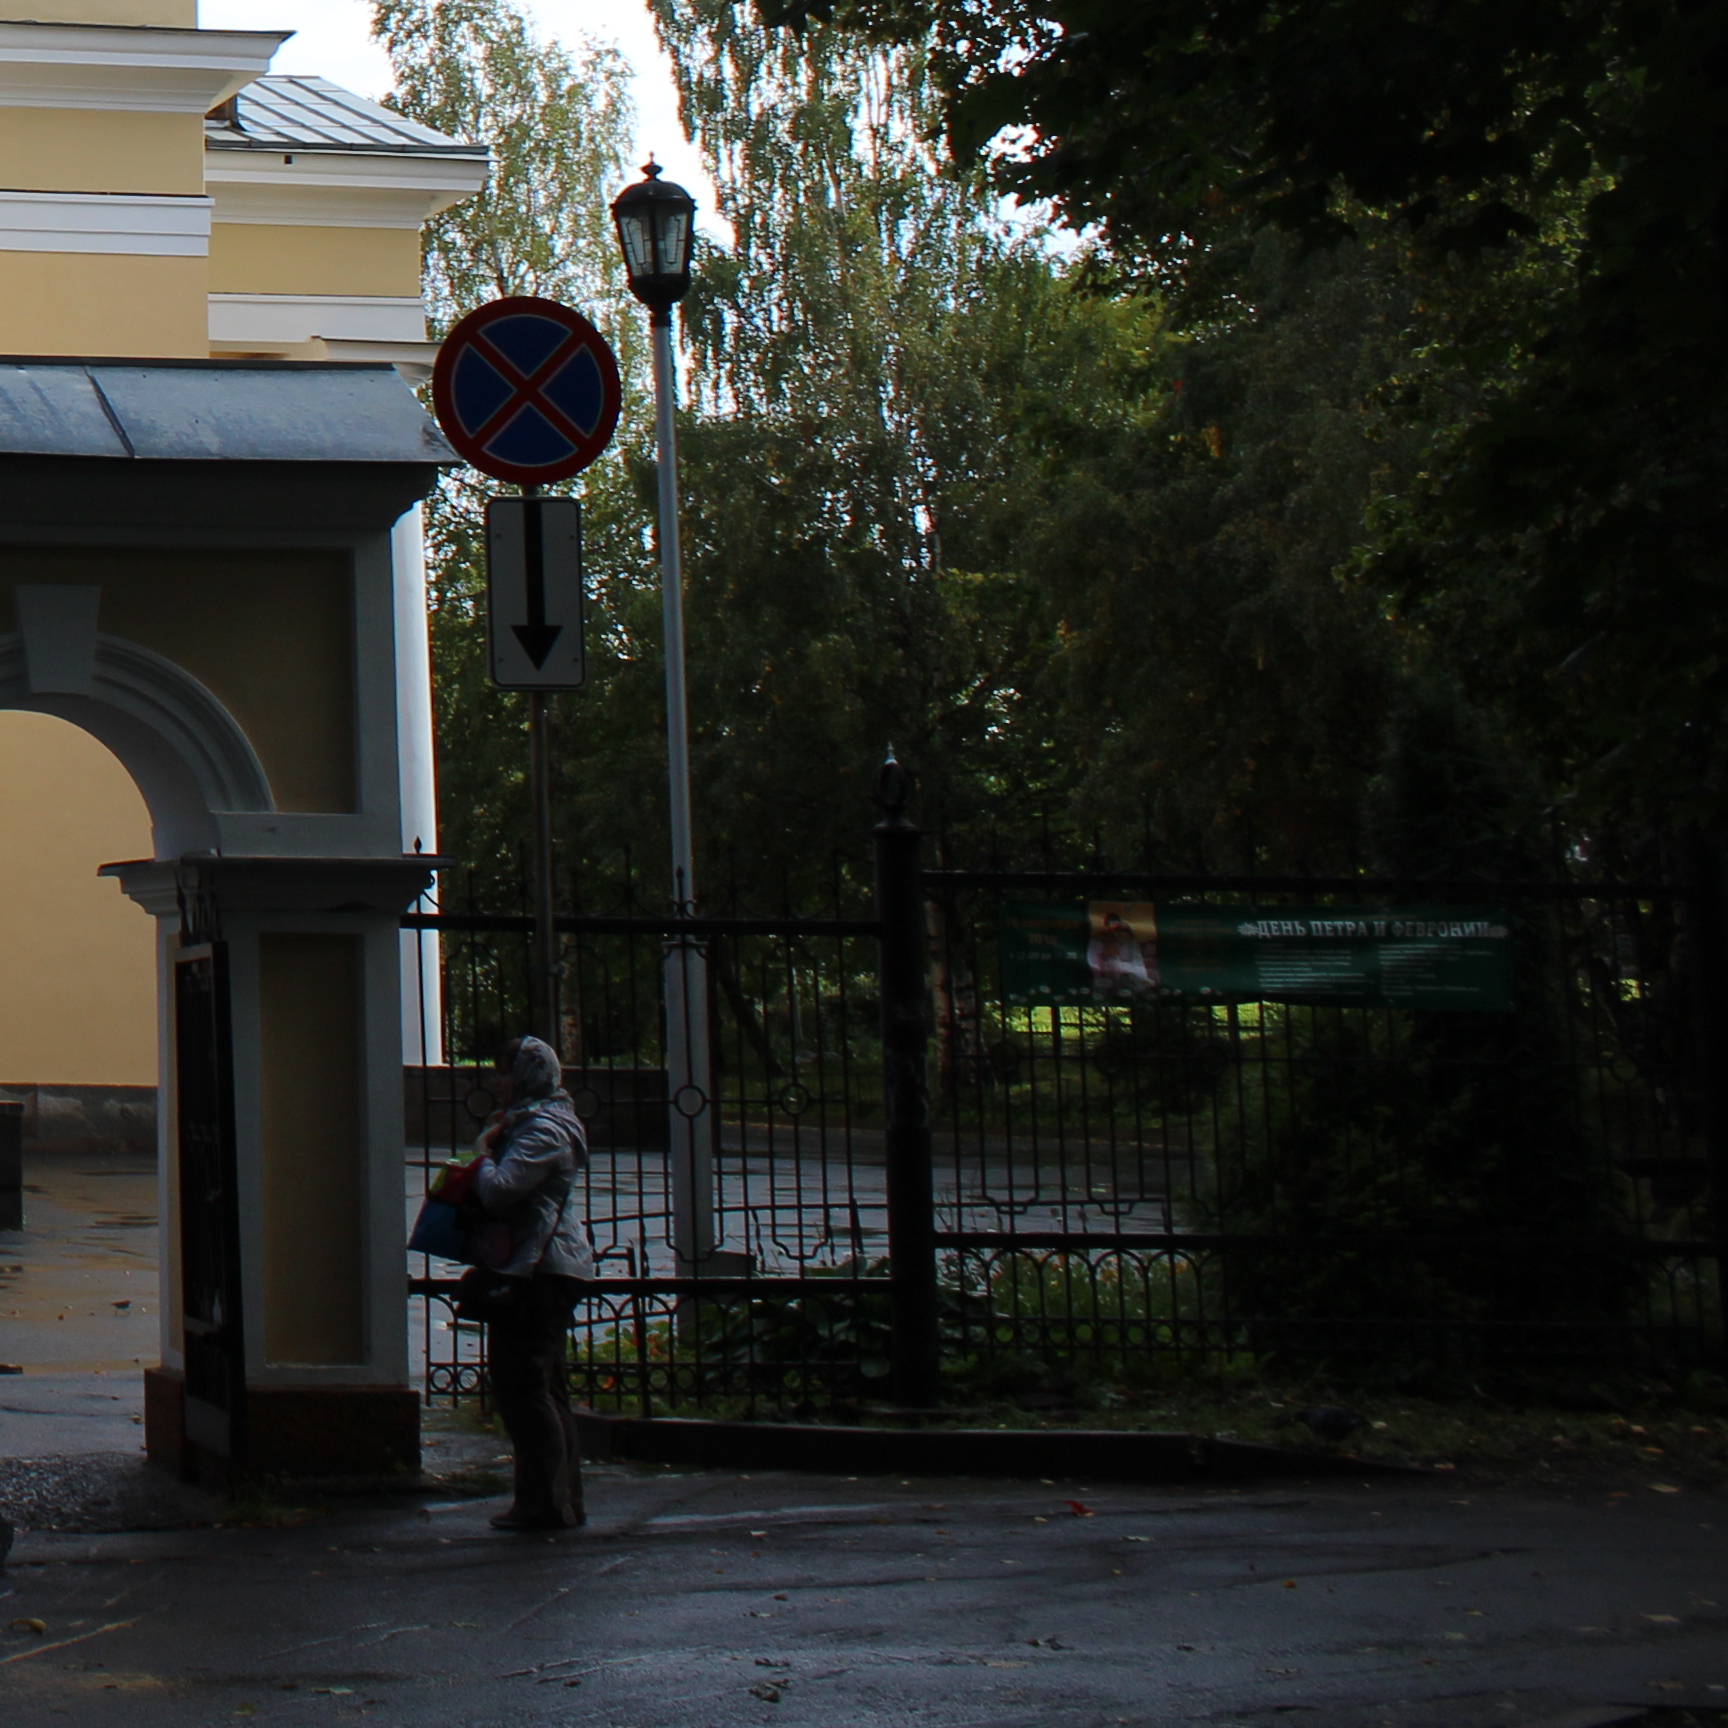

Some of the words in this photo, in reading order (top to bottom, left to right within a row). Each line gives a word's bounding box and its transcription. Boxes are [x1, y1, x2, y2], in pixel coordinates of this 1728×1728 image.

[1257, 920, 1307, 939] ДЕНЬ
[1309, 920, 1367, 936] ПЕТРА
[1372, 920, 1388, 936] И
[1392, 920, 1490, 937] ФЕВРОНИИ
